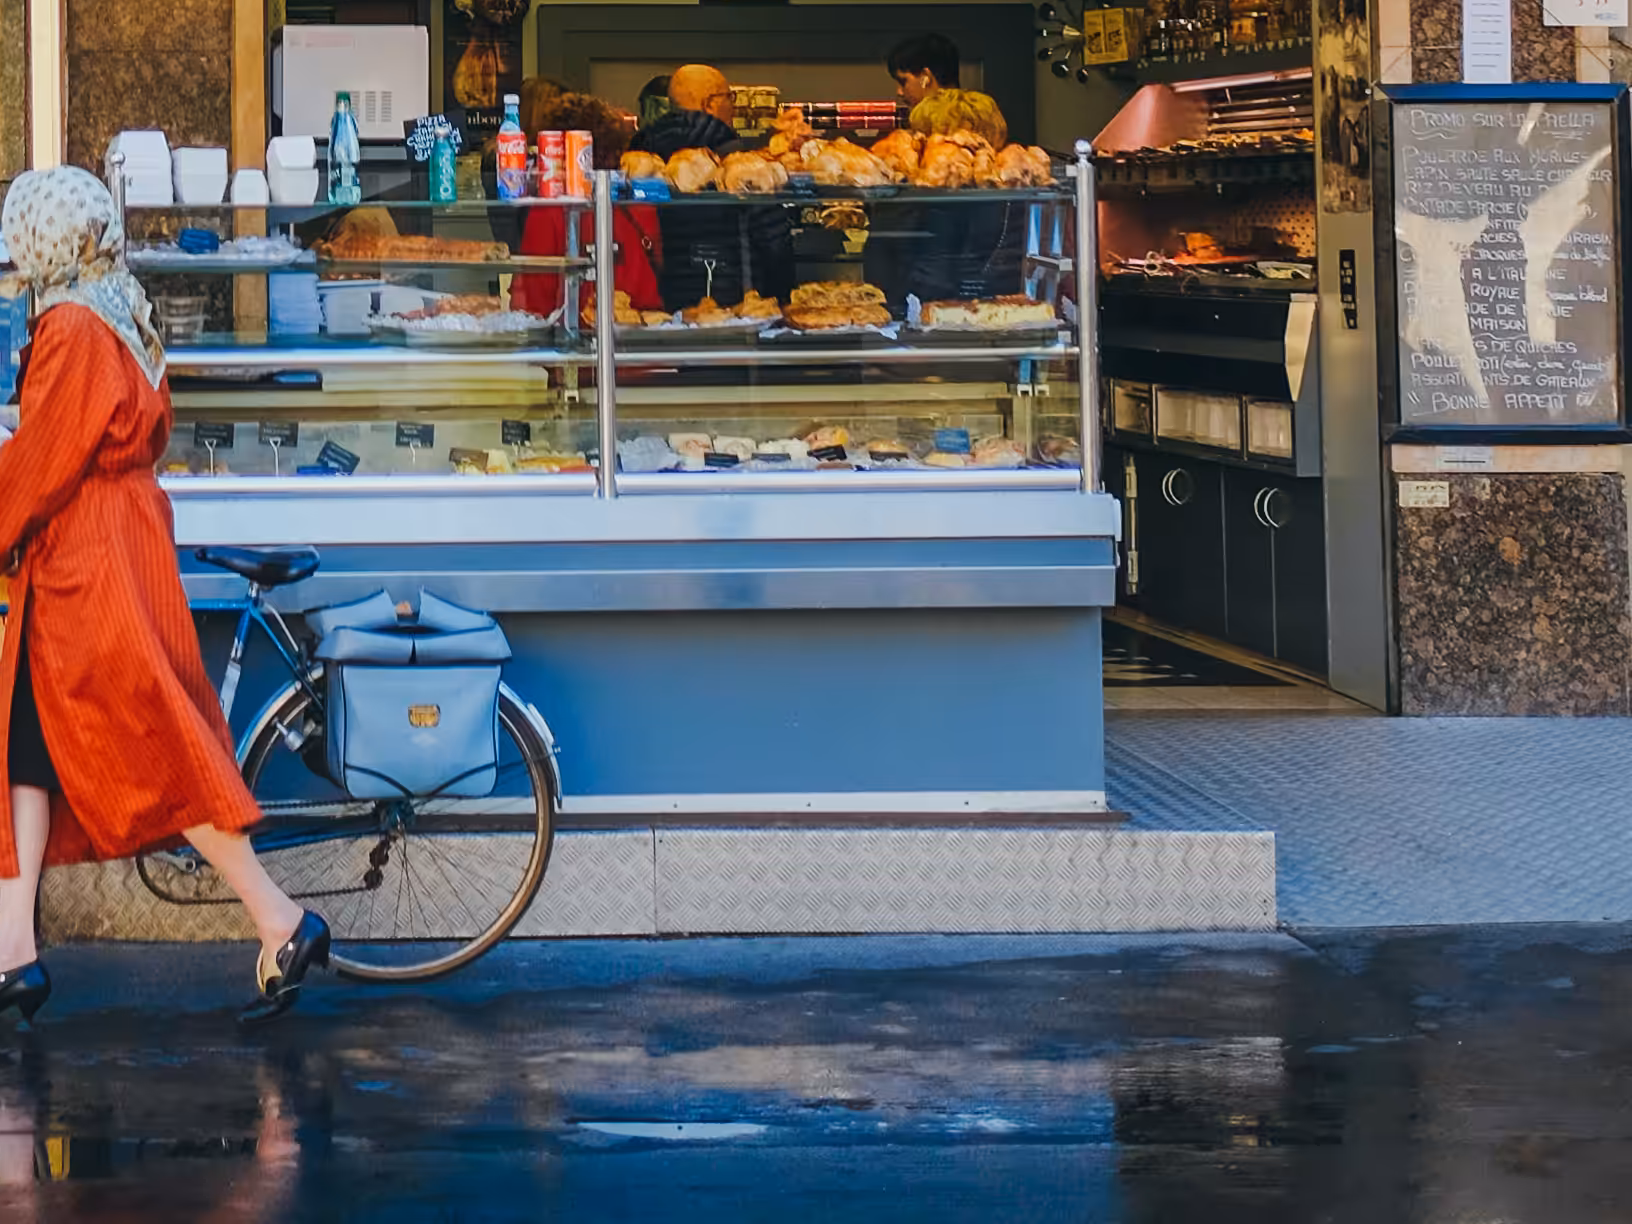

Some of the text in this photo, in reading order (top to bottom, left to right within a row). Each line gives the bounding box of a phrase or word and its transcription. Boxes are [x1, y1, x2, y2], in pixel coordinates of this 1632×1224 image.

[1411, 109, 1466, 128] PROMO
[1472, 112, 1505, 128] SUR
[1471, 283, 1520, 301] ROYALE
[1496, 305, 1516, 316] DE
[1471, 318, 1527, 331] MAISON
[1491, 340, 1512, 353] DE
[1512, 375, 1532, 386] DE
